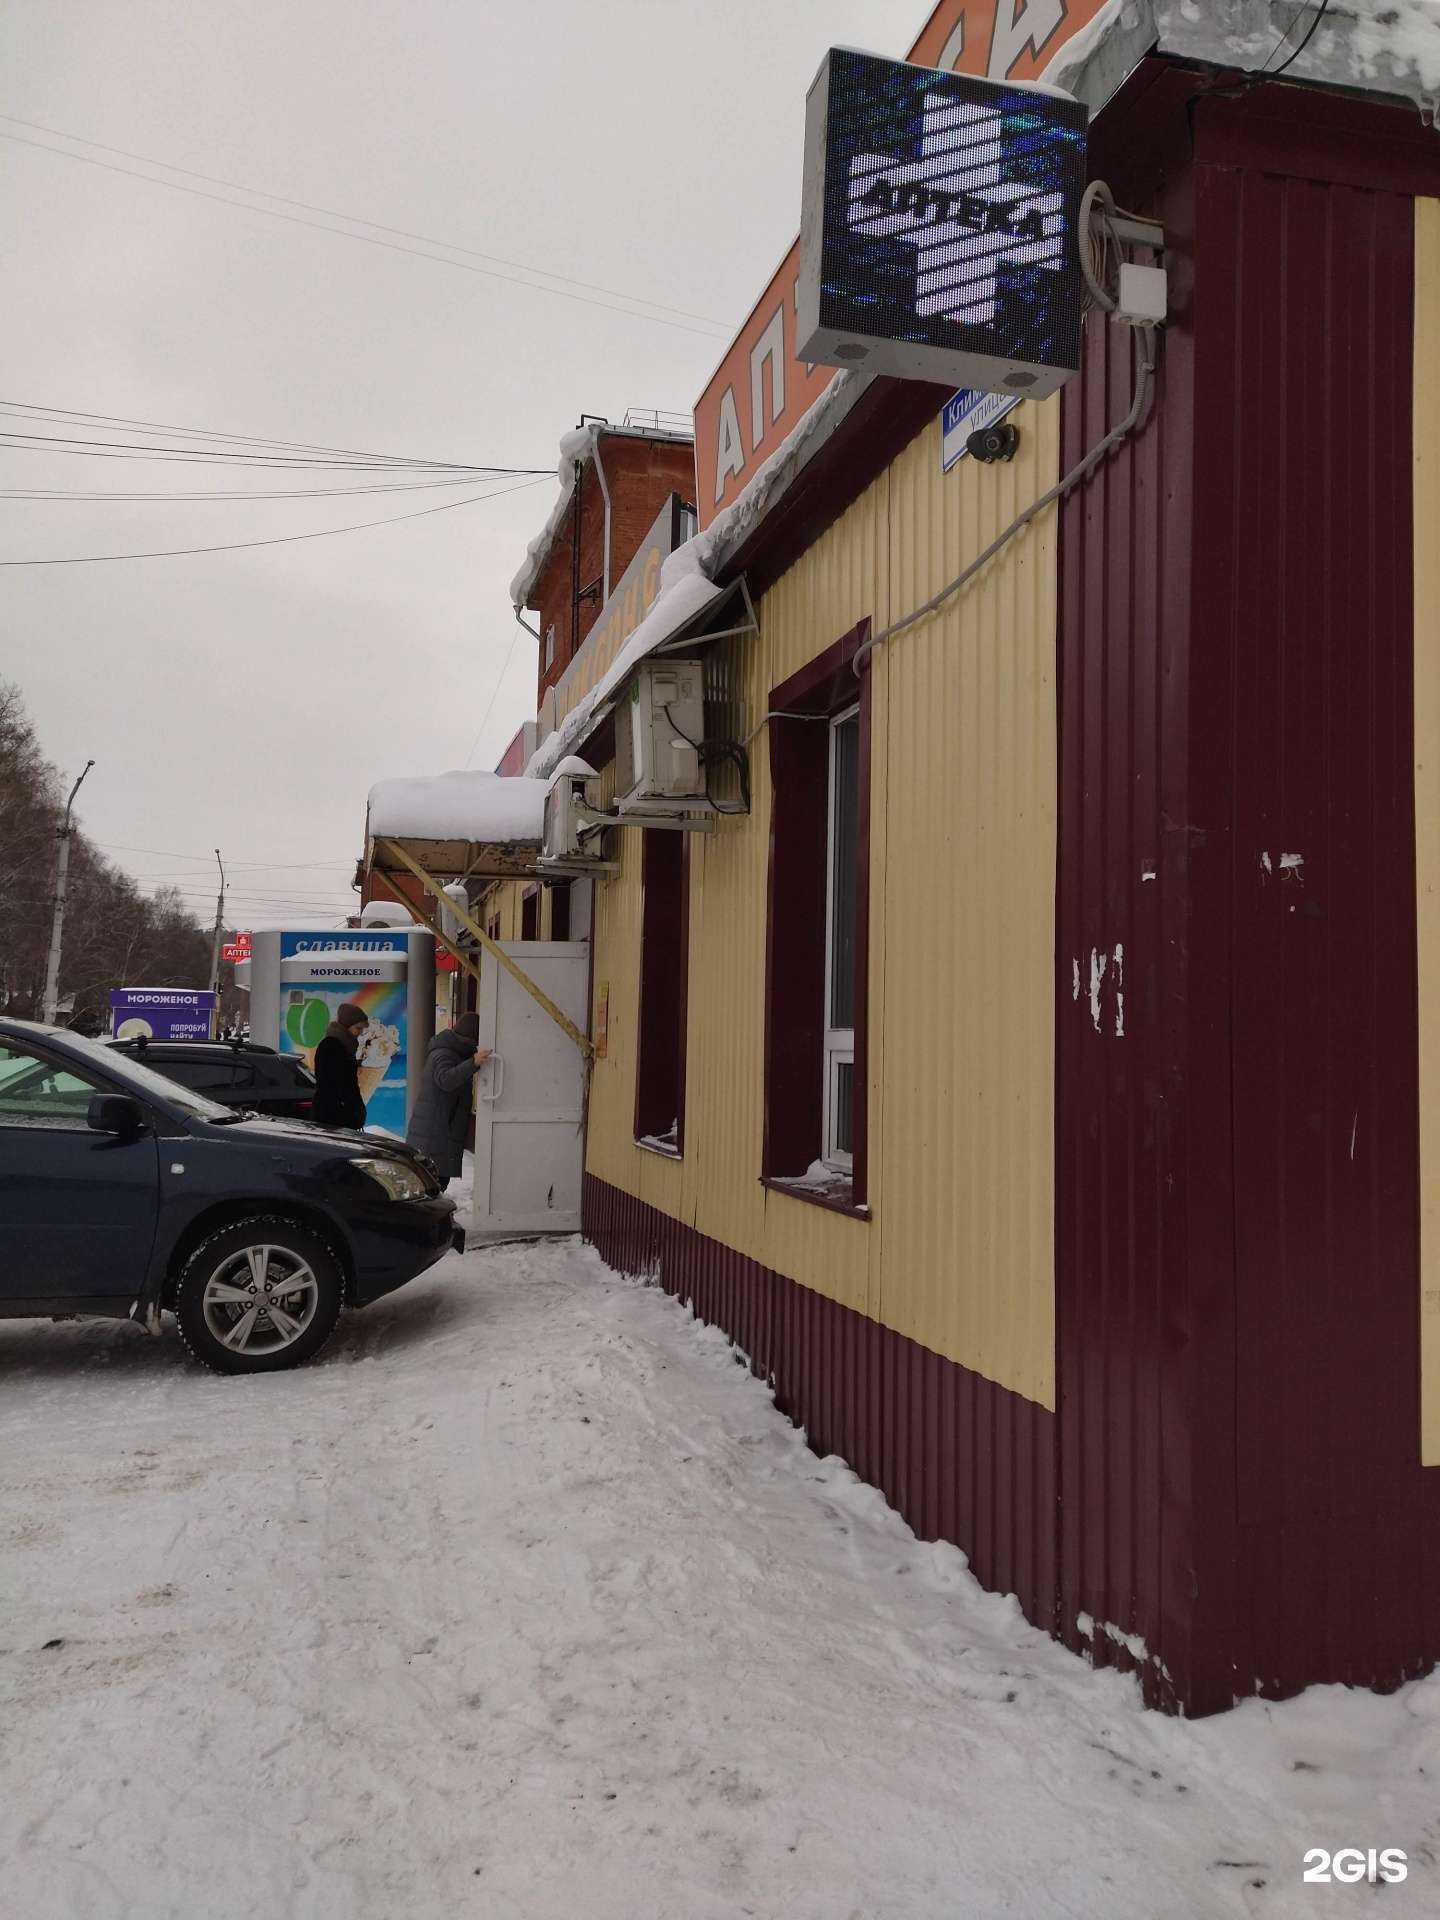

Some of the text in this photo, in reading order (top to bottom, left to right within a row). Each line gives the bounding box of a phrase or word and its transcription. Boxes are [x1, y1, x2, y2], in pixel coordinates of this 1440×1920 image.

[862, 178, 1045, 239] АПТЕКА
[226, 949, 251, 957] АПТЕ
[310, 968, 381, 976] МОРОЖЕНОЕ
[127, 994, 199, 1004] МОРОЖЕНОЕ
[170, 1022, 207, 1032] ПОПРОБУЙ
